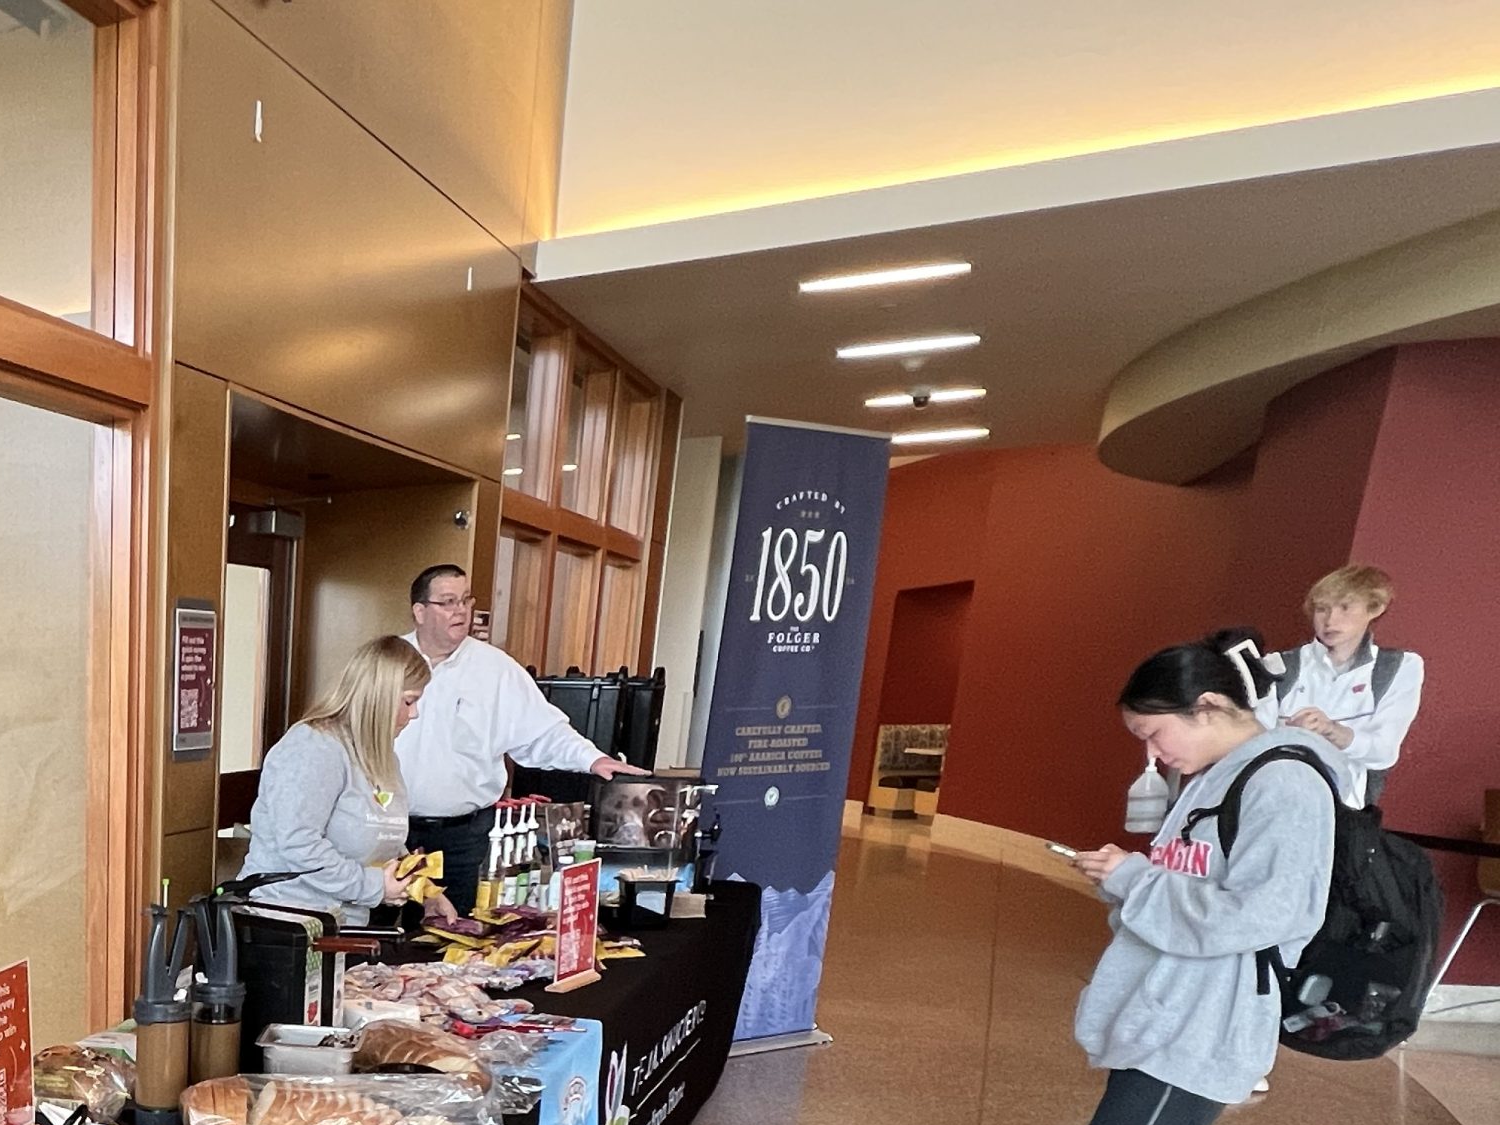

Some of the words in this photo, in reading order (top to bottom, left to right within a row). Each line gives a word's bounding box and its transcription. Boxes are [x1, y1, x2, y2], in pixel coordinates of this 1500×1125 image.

[776, 490, 828, 510] CRAFTED
[749, 526, 848, 622] 1850
[767, 632, 820, 644] FOLGER
[772, 645, 799, 653] COFFEE
[4, 1024, 17, 1037] win
